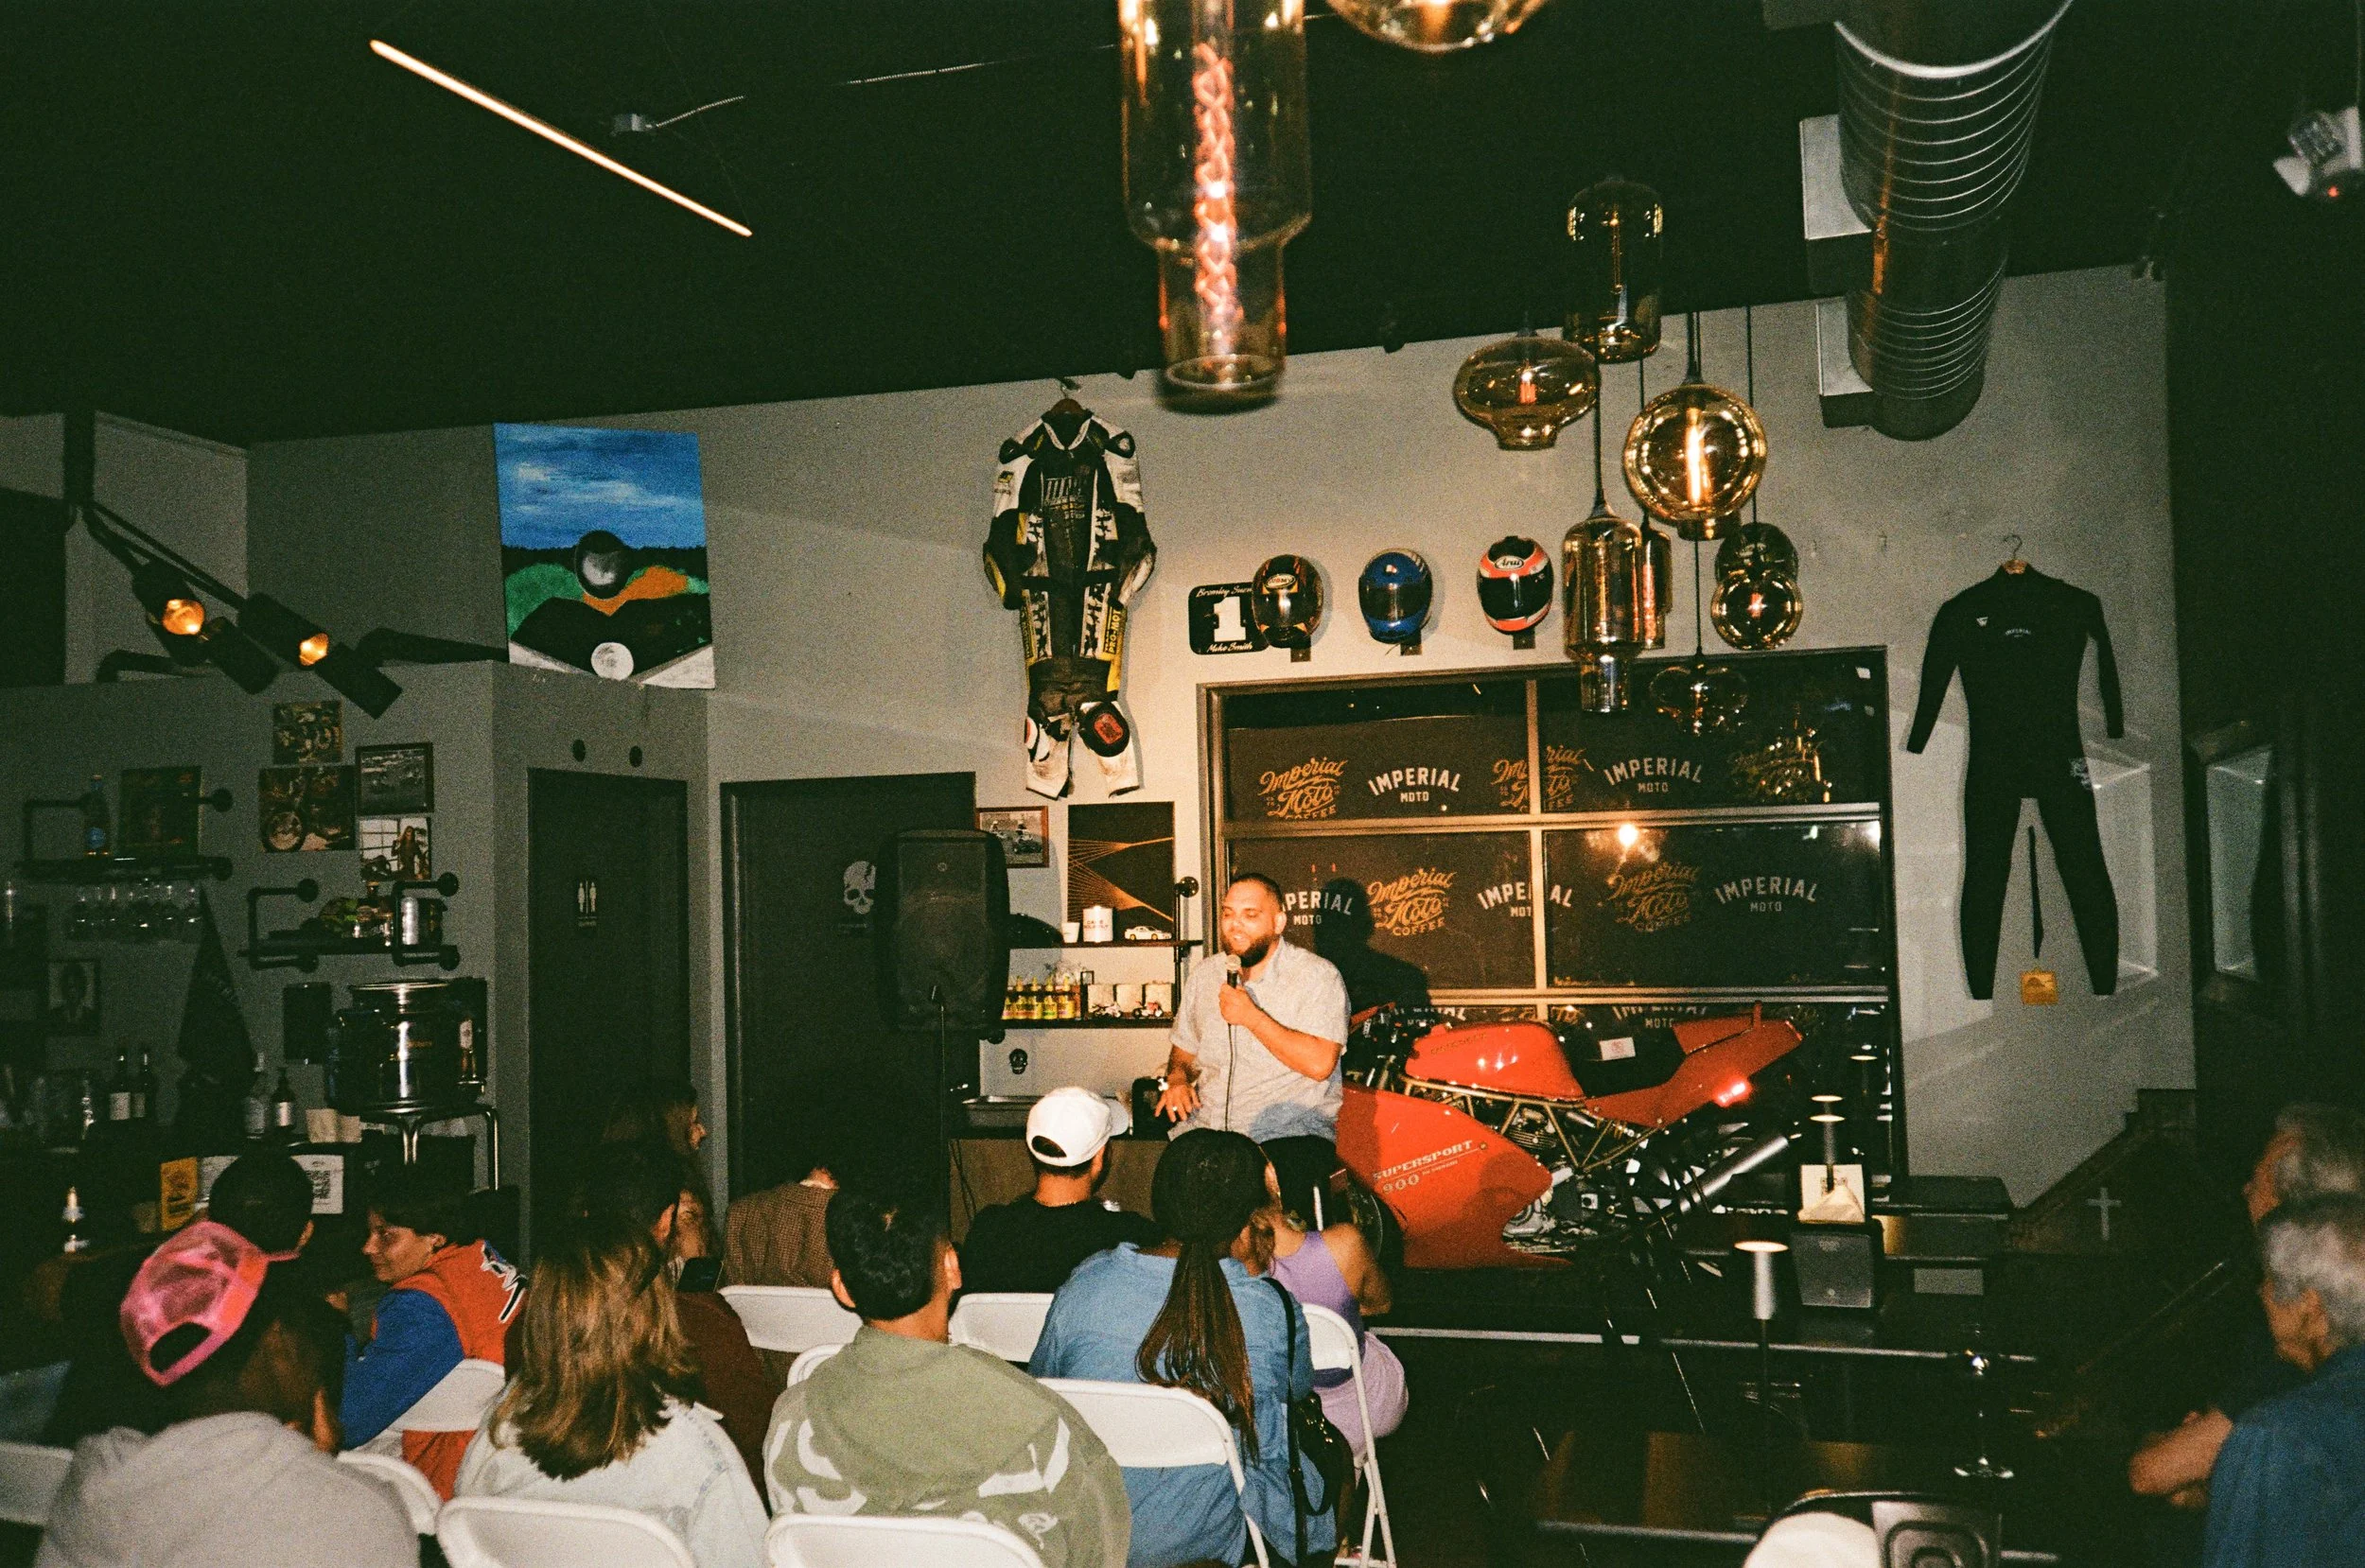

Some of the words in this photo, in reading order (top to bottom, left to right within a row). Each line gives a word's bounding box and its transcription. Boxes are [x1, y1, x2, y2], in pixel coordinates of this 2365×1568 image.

[1214, 597, 1246, 642] 1
[1228, 641, 1253, 652] Smith
[1257, 757, 1348, 795] Imperial
[1368, 767, 1461, 795] IMPERIAL
[1603, 758, 1702, 786] IMPERIAL
[1268, 784, 1336, 817] Moto
[1400, 792, 1429, 803] MOTO
[1638, 783, 1669, 793] MOTO
[1366, 867, 1458, 906] Imperial
[1605, 861, 1700, 900] Imperial
[1714, 876, 1817, 904] IMPERIAL
[1282, 891, 1353, 915] PERIAL
[1374, 897, 1444, 929] Moto
[1510, 906, 1531, 917] MOT
[1750, 901, 1781, 913] MOTO
[1293, 915, 1322, 926] MOTO
[1393, 916, 1445, 936] COFFEE
[1373, 1140, 1473, 1181] SUPERSPORT
[1382, 1174, 1419, 1194] 900
